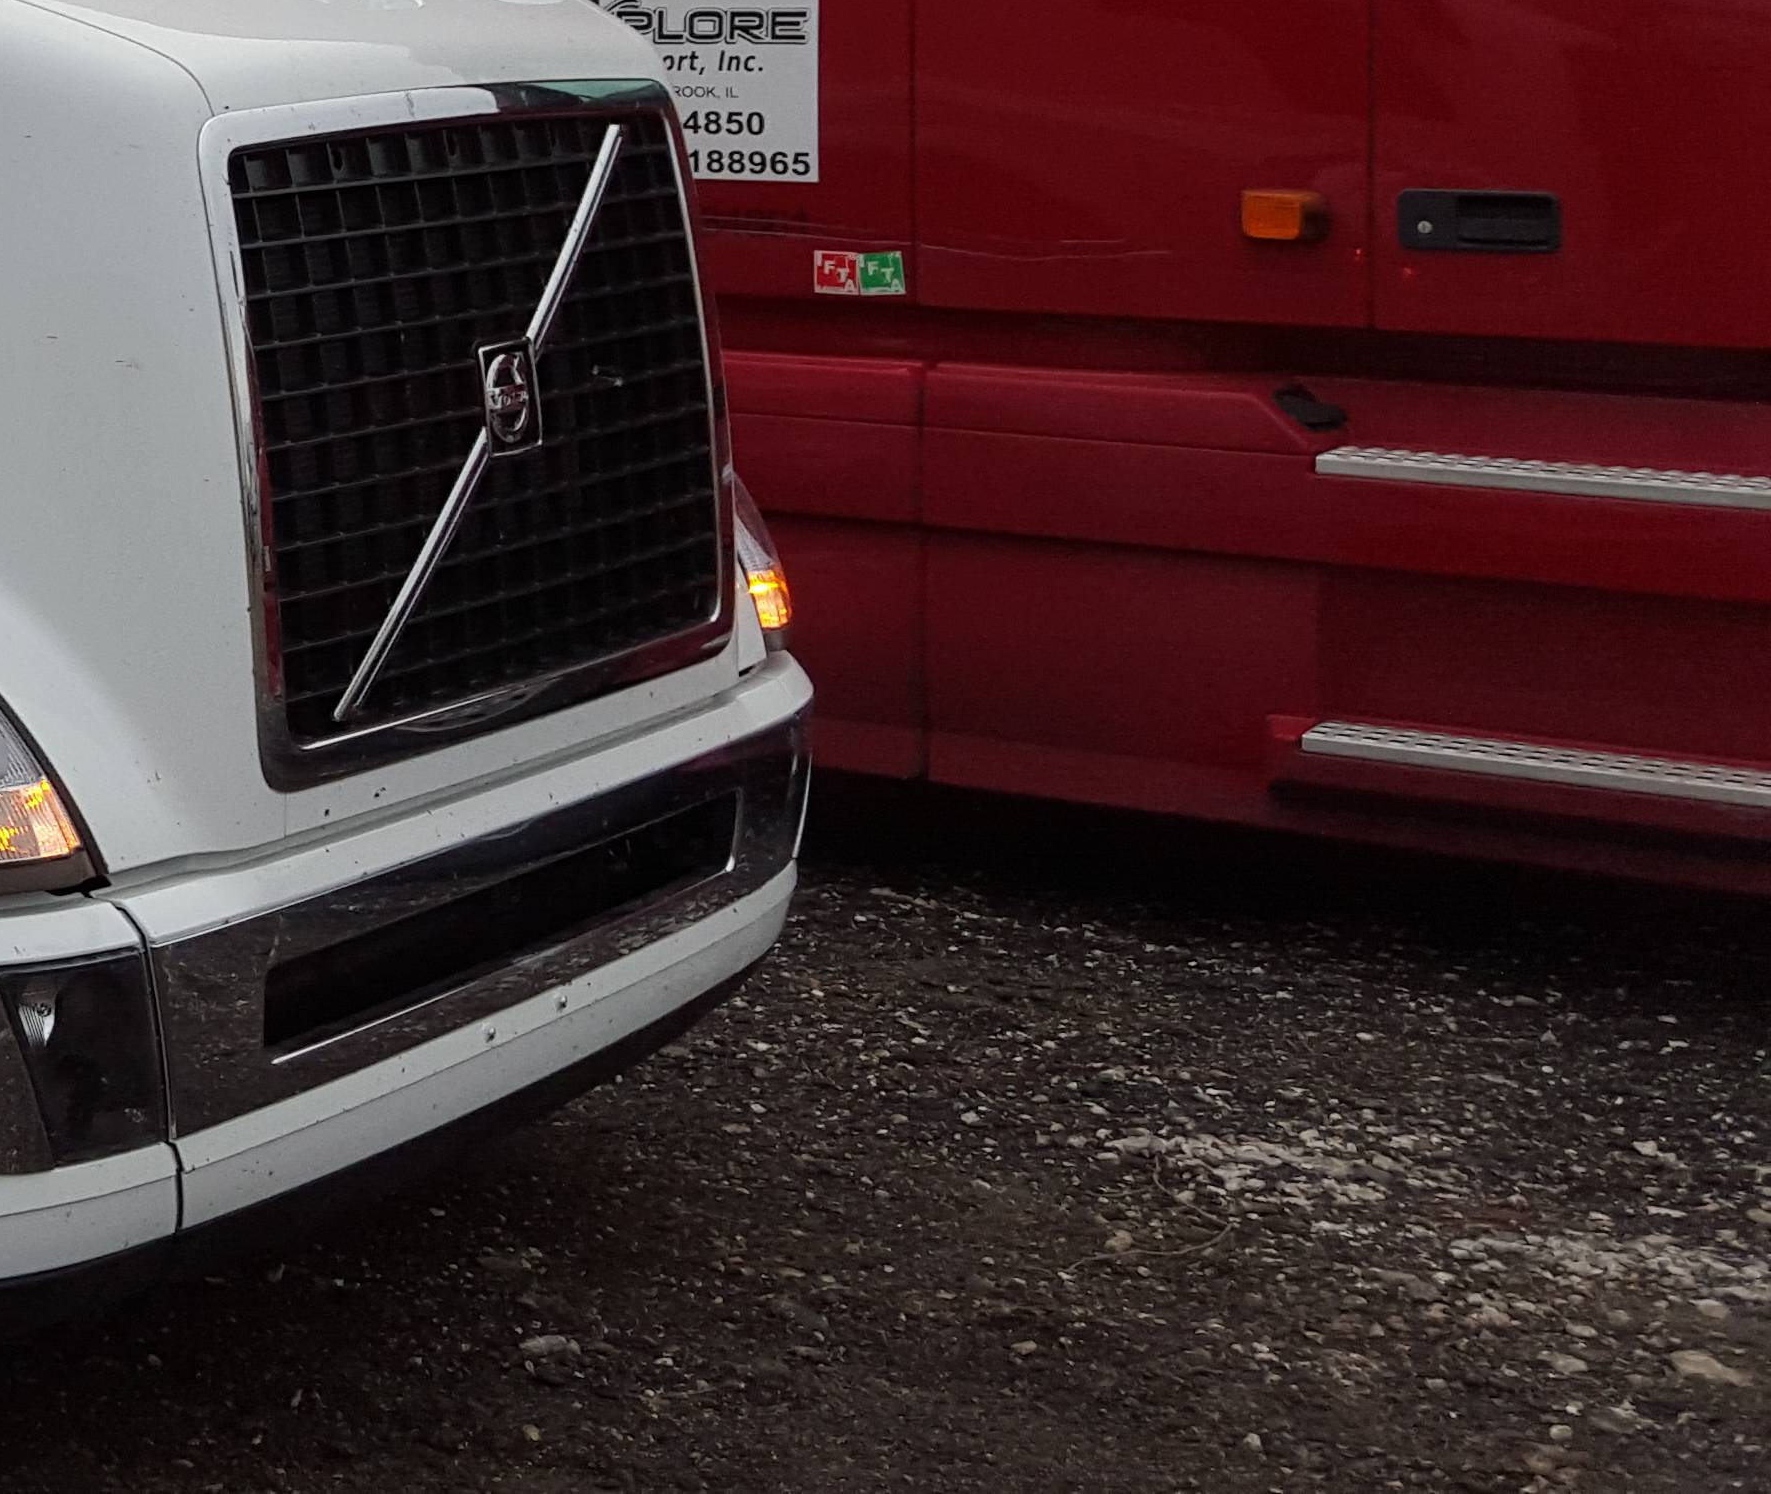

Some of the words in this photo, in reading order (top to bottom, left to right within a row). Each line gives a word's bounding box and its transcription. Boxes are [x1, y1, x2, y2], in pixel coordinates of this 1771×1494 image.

[662, 49, 706, 76] ort,
[717, 49, 764, 73] Inc.
[674, 85, 721, 100] ROOK,
[725, 86, 740, 99] IL
[682, 110, 766, 136] 4850
[688, 149, 811, 177] 188965
